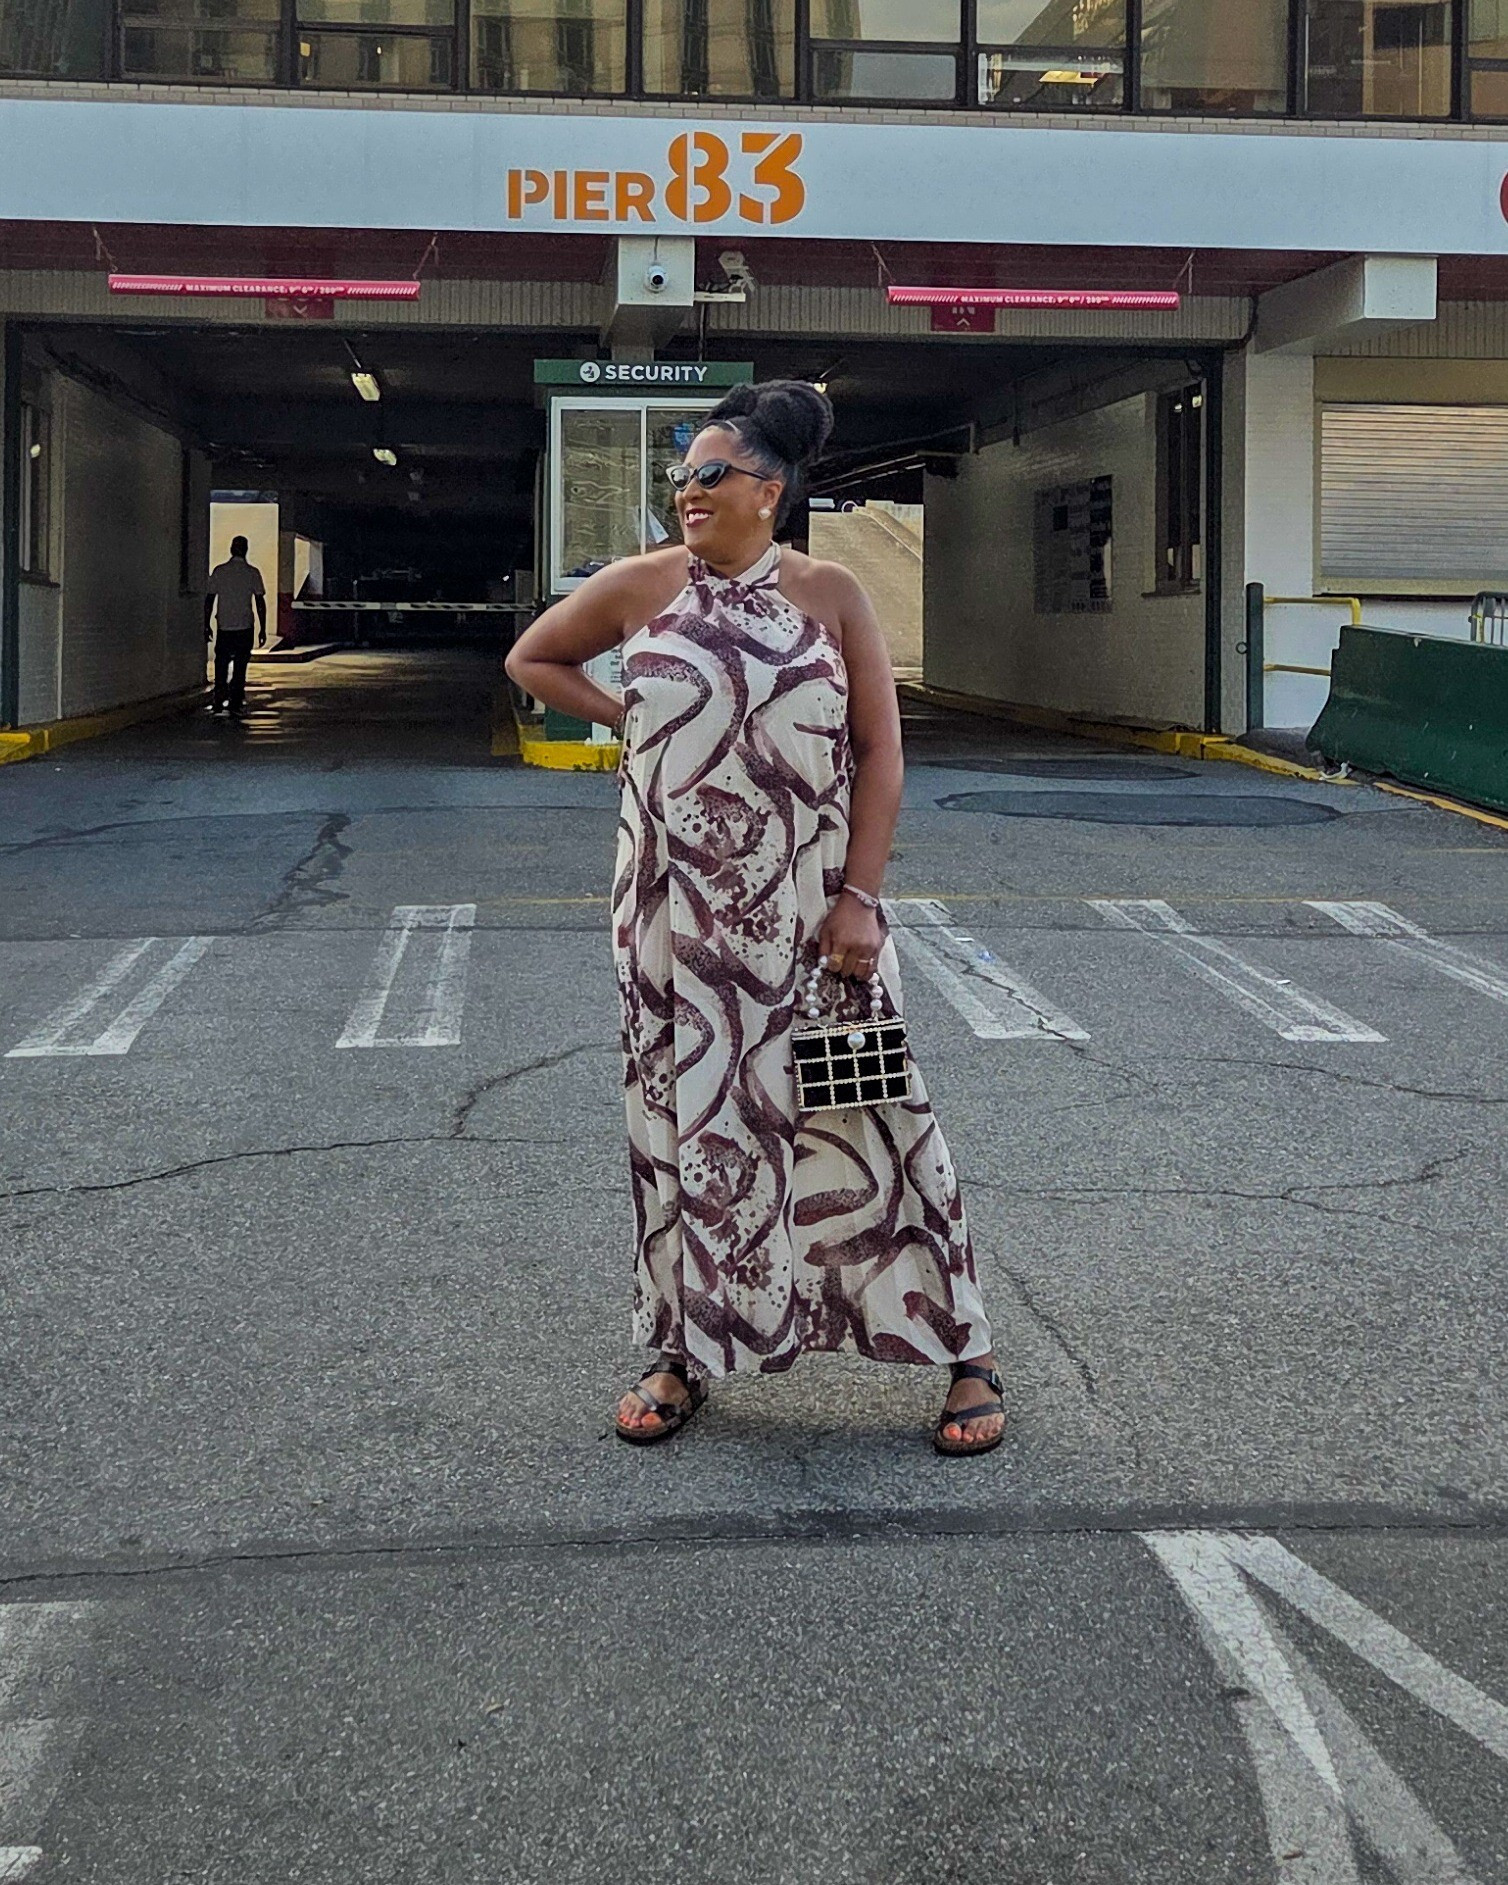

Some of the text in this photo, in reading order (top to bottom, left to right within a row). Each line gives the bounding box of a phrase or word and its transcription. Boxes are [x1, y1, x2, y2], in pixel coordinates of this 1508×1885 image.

[507, 130, 805, 224] PIER 83
[185, 284, 231, 292] MAXIMUM
[960, 295, 1003, 303] MAXIMUM
[605, 364, 708, 382] SECURITY
